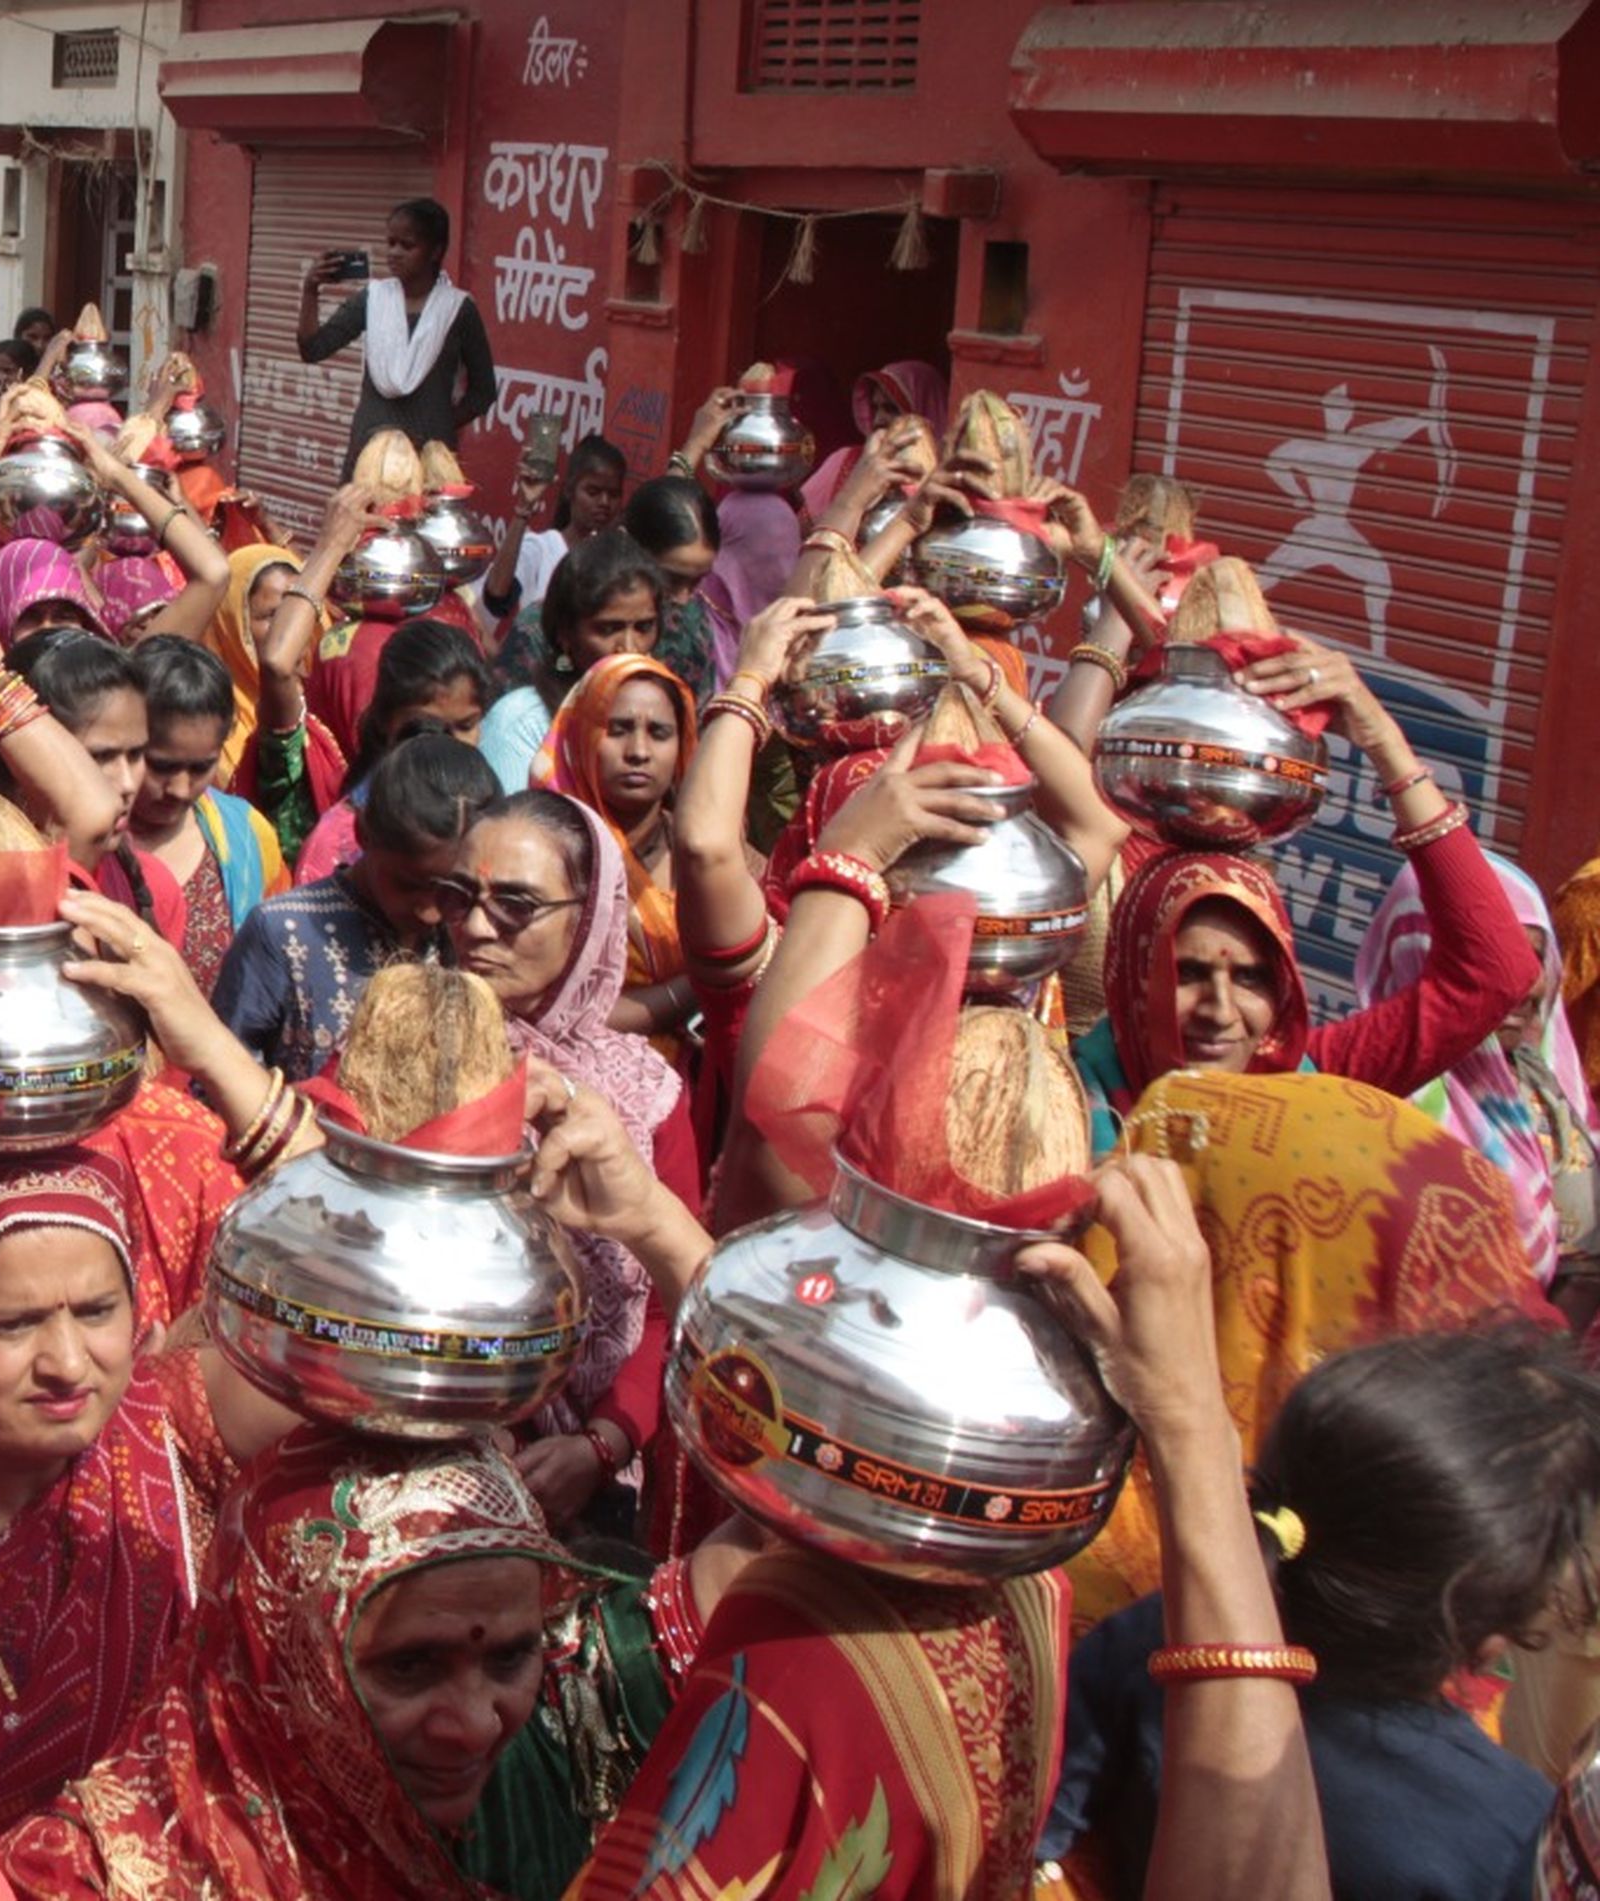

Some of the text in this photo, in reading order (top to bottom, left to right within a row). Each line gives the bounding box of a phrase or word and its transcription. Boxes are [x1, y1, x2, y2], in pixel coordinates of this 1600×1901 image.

[494, 226, 595, 331] सीमेंट
[315, 1317, 440, 1352] Padmawati
[852, 1460, 922, 1502] SRM
